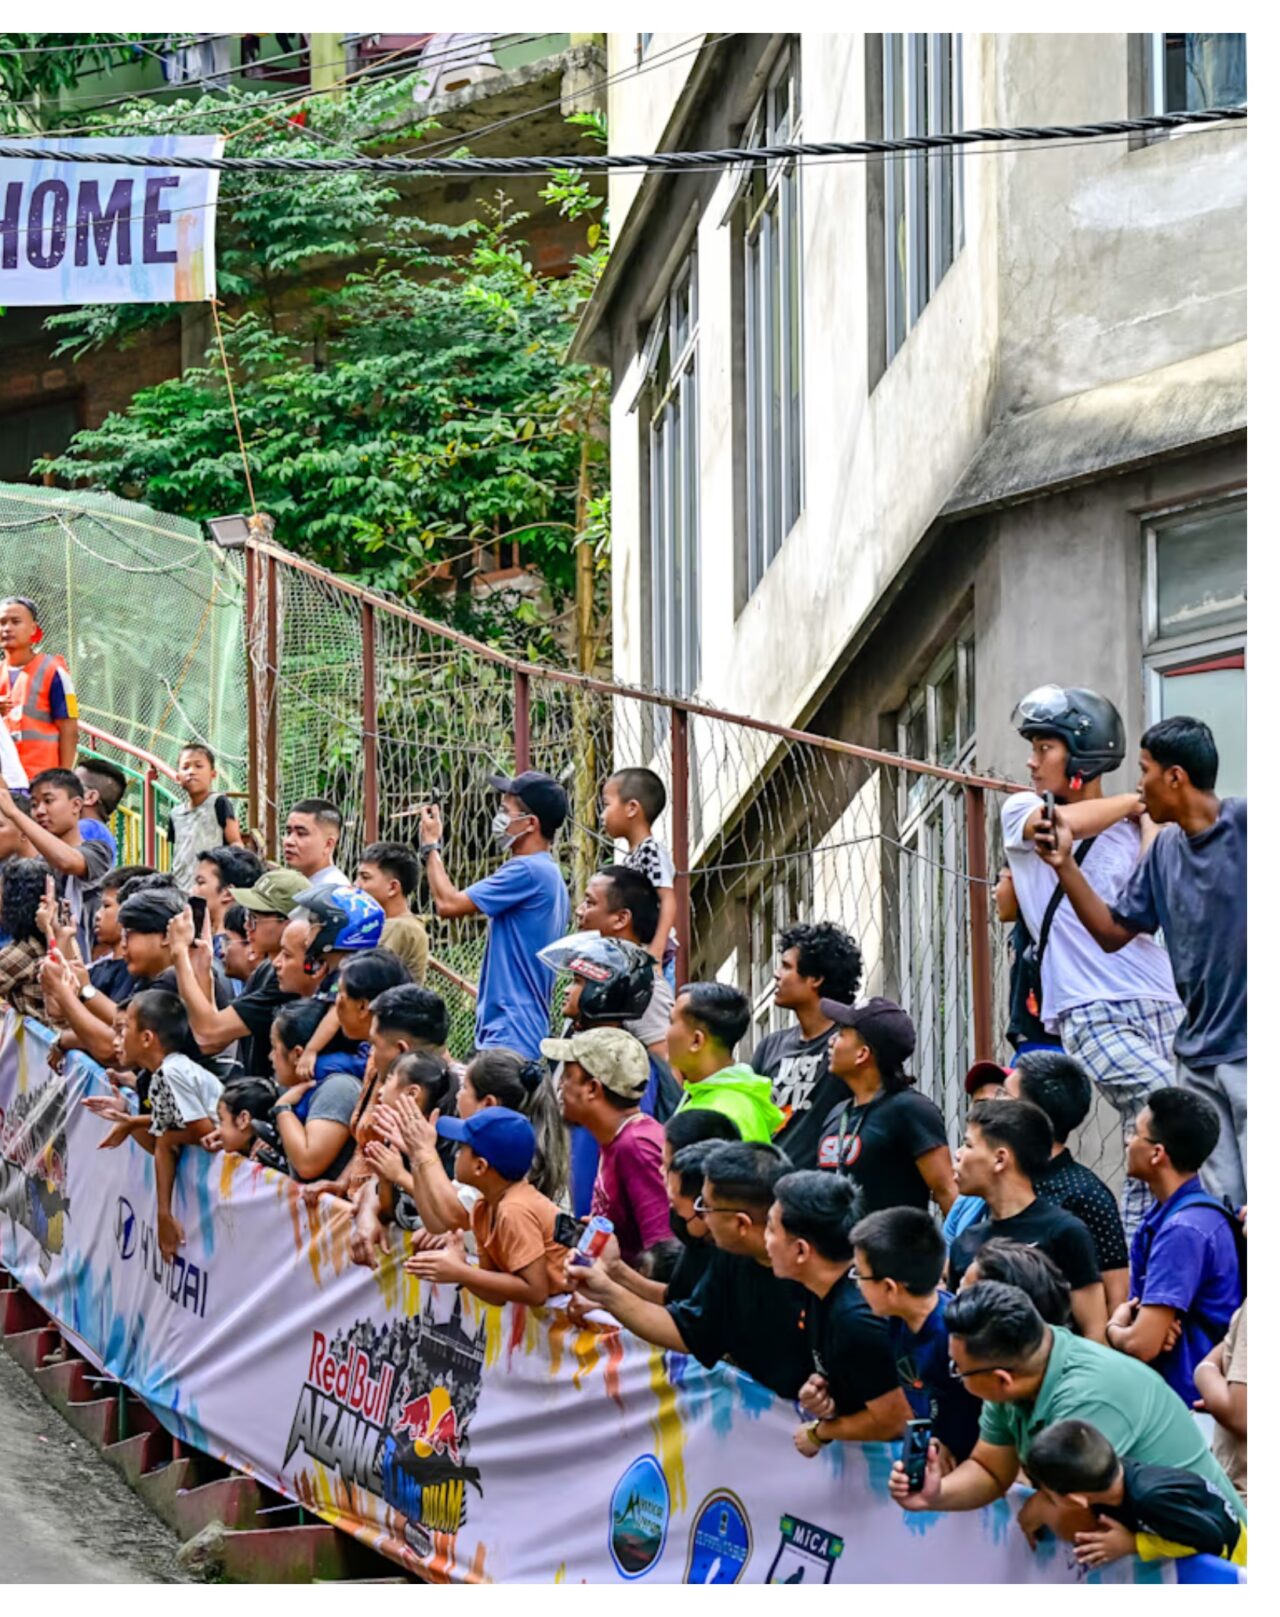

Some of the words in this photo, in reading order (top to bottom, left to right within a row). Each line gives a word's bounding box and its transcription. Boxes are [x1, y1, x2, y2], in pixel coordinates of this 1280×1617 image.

[308, 1330, 356, 1401] Red
[349, 1350, 396, 1426] Bull
[282, 1384, 384, 1500] AIZAWL
